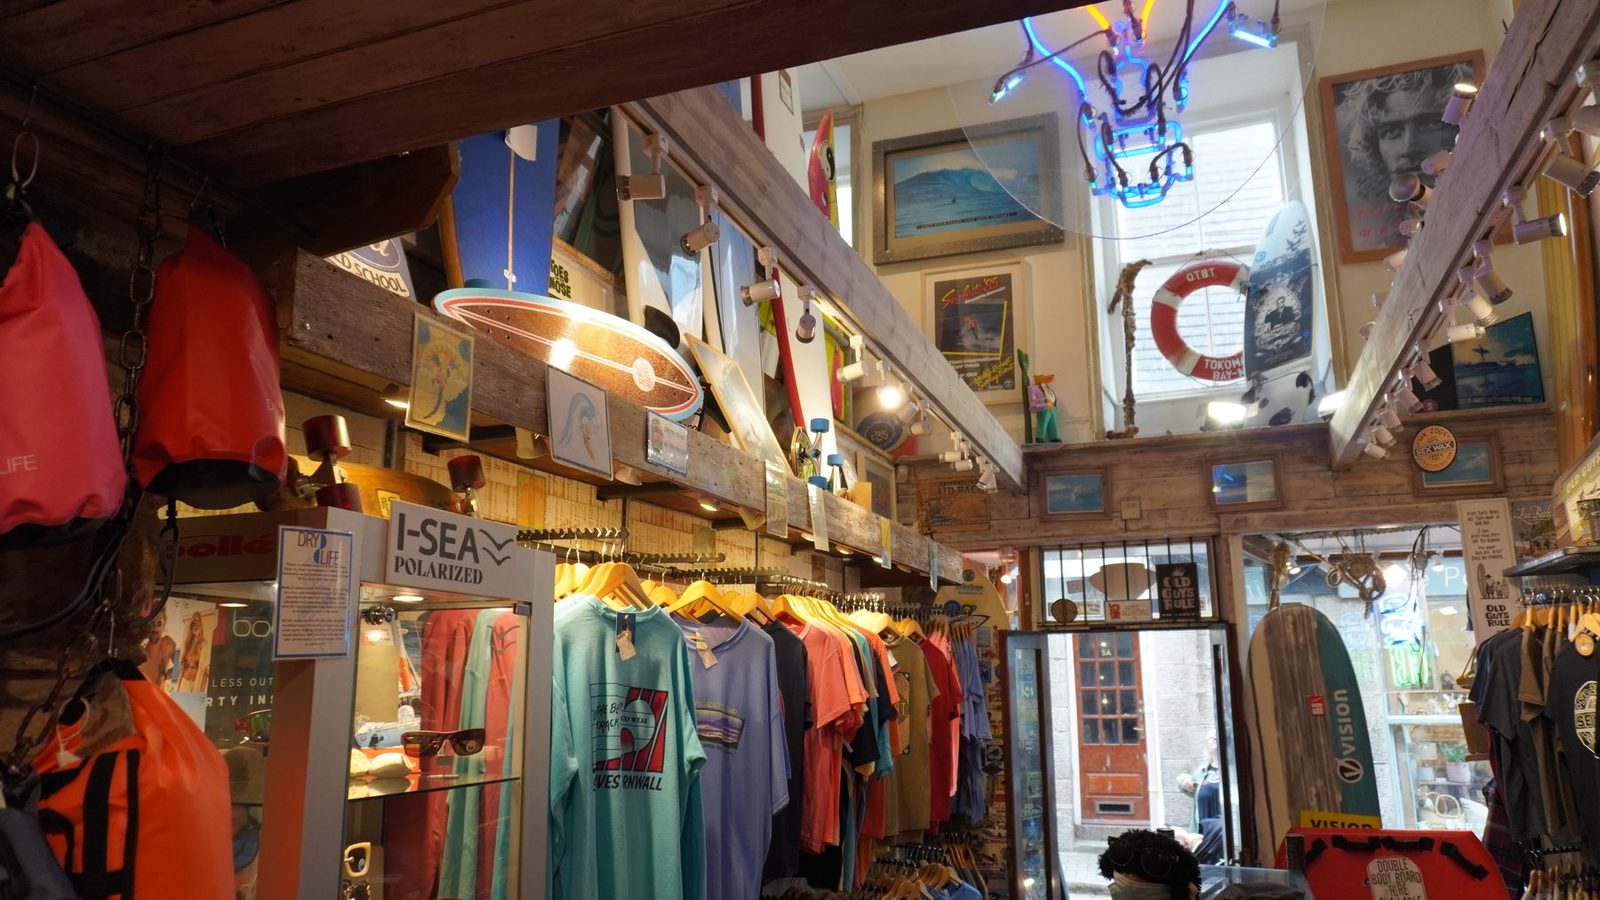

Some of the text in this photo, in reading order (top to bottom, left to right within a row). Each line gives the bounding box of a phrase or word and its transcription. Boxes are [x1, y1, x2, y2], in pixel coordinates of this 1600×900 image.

[354, 263, 407, 292] SCHOOL
[1433, 441, 1451, 452] WAX
[297, 531, 320, 548] DRY
[397, 512, 480, 564] I-SEA
[320, 550, 340, 565] LIFE
[394, 555, 483, 585] POLARIZED
[1163, 576, 1191, 588] OLD
[1162, 587, 1194, 599] GUYS
[1163, 598, 1196, 610] RULE
[1486, 604, 1506, 612] OLD
[1485, 612, 1510, 620] GUYS
[1487, 619, 1511, 628] RULE
[210, 677, 242, 688] LESS
[205, 696, 239, 707] RTY
[1377, 858, 1409, 873] DOUBLE
[1372, 871, 1422, 885] BODY BOARD
